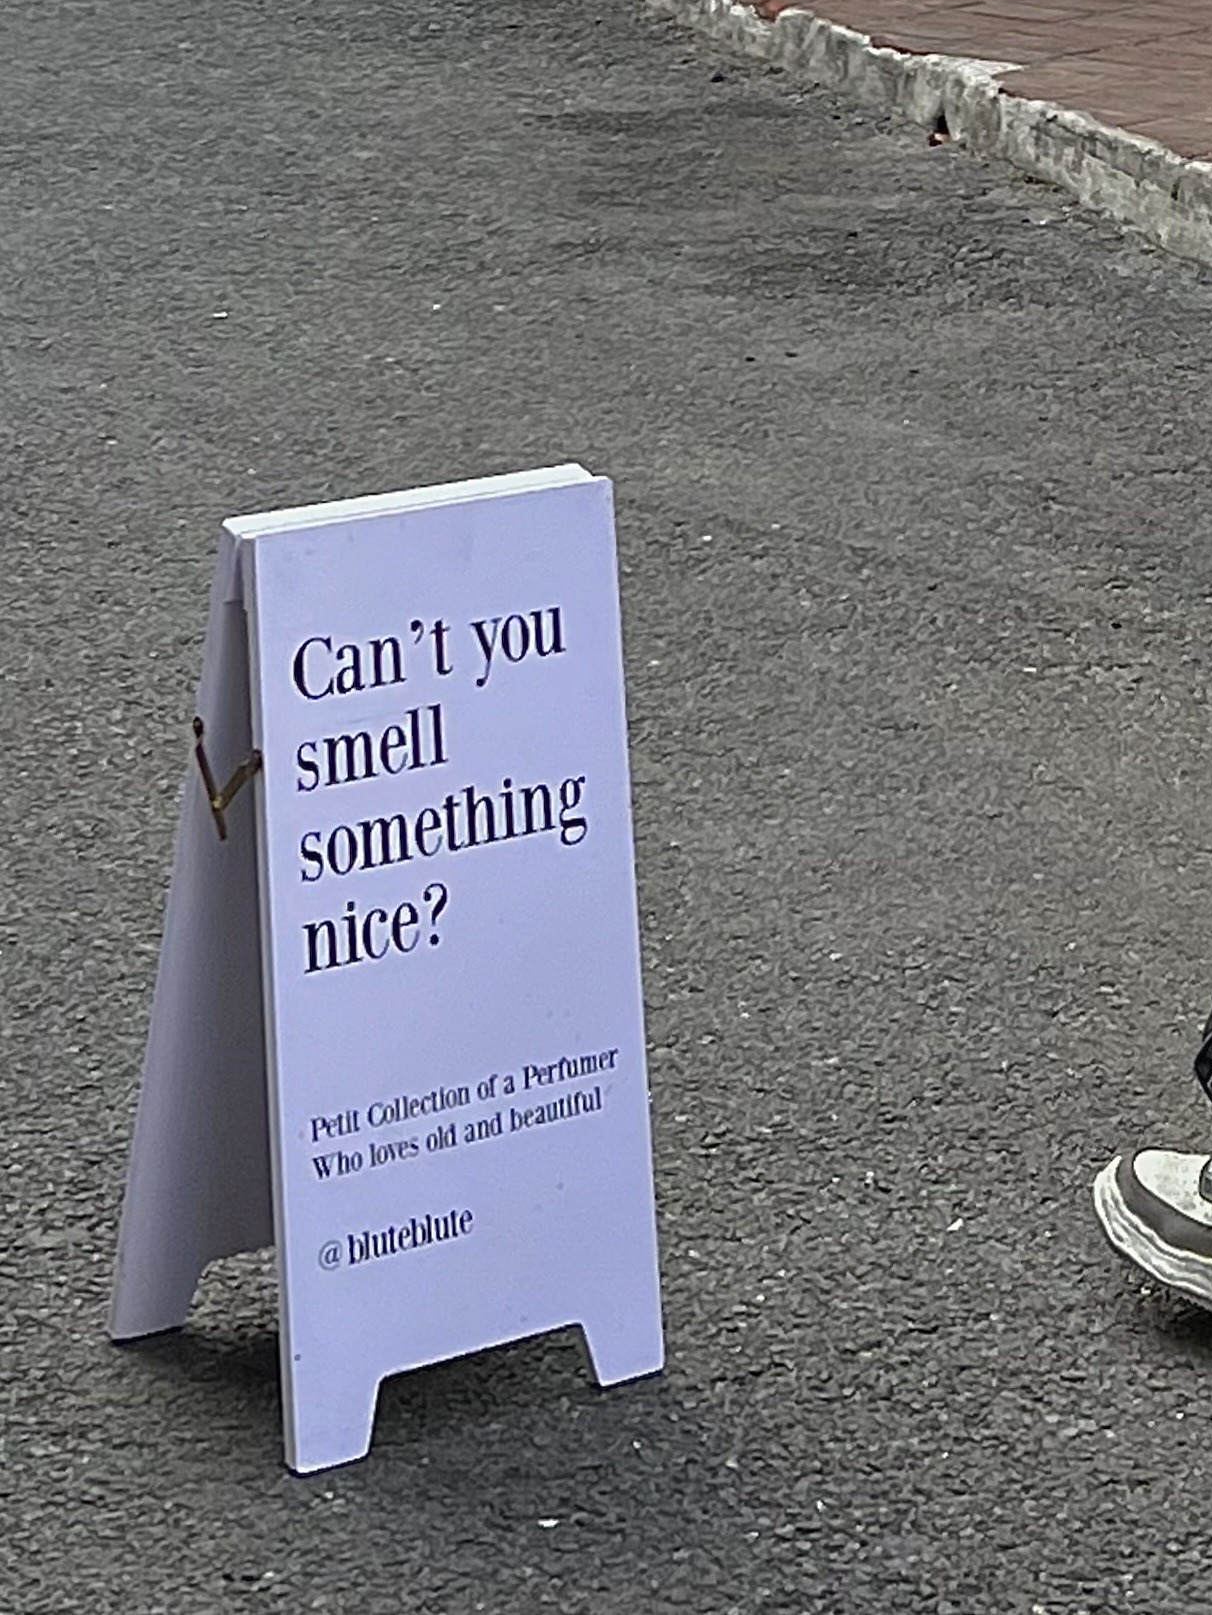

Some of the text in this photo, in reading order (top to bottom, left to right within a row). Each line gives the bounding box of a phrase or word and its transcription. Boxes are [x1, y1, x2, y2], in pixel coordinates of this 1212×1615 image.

[292, 605, 566, 700] Can’t you
[295, 703, 449, 792] smell
[300, 774, 589, 883] something
[302, 882, 448, 974] nice?
[310, 1047, 619, 1142] Petit Collection of a Perfumer
[312, 1086, 603, 1181] Who loves old and beautiful
